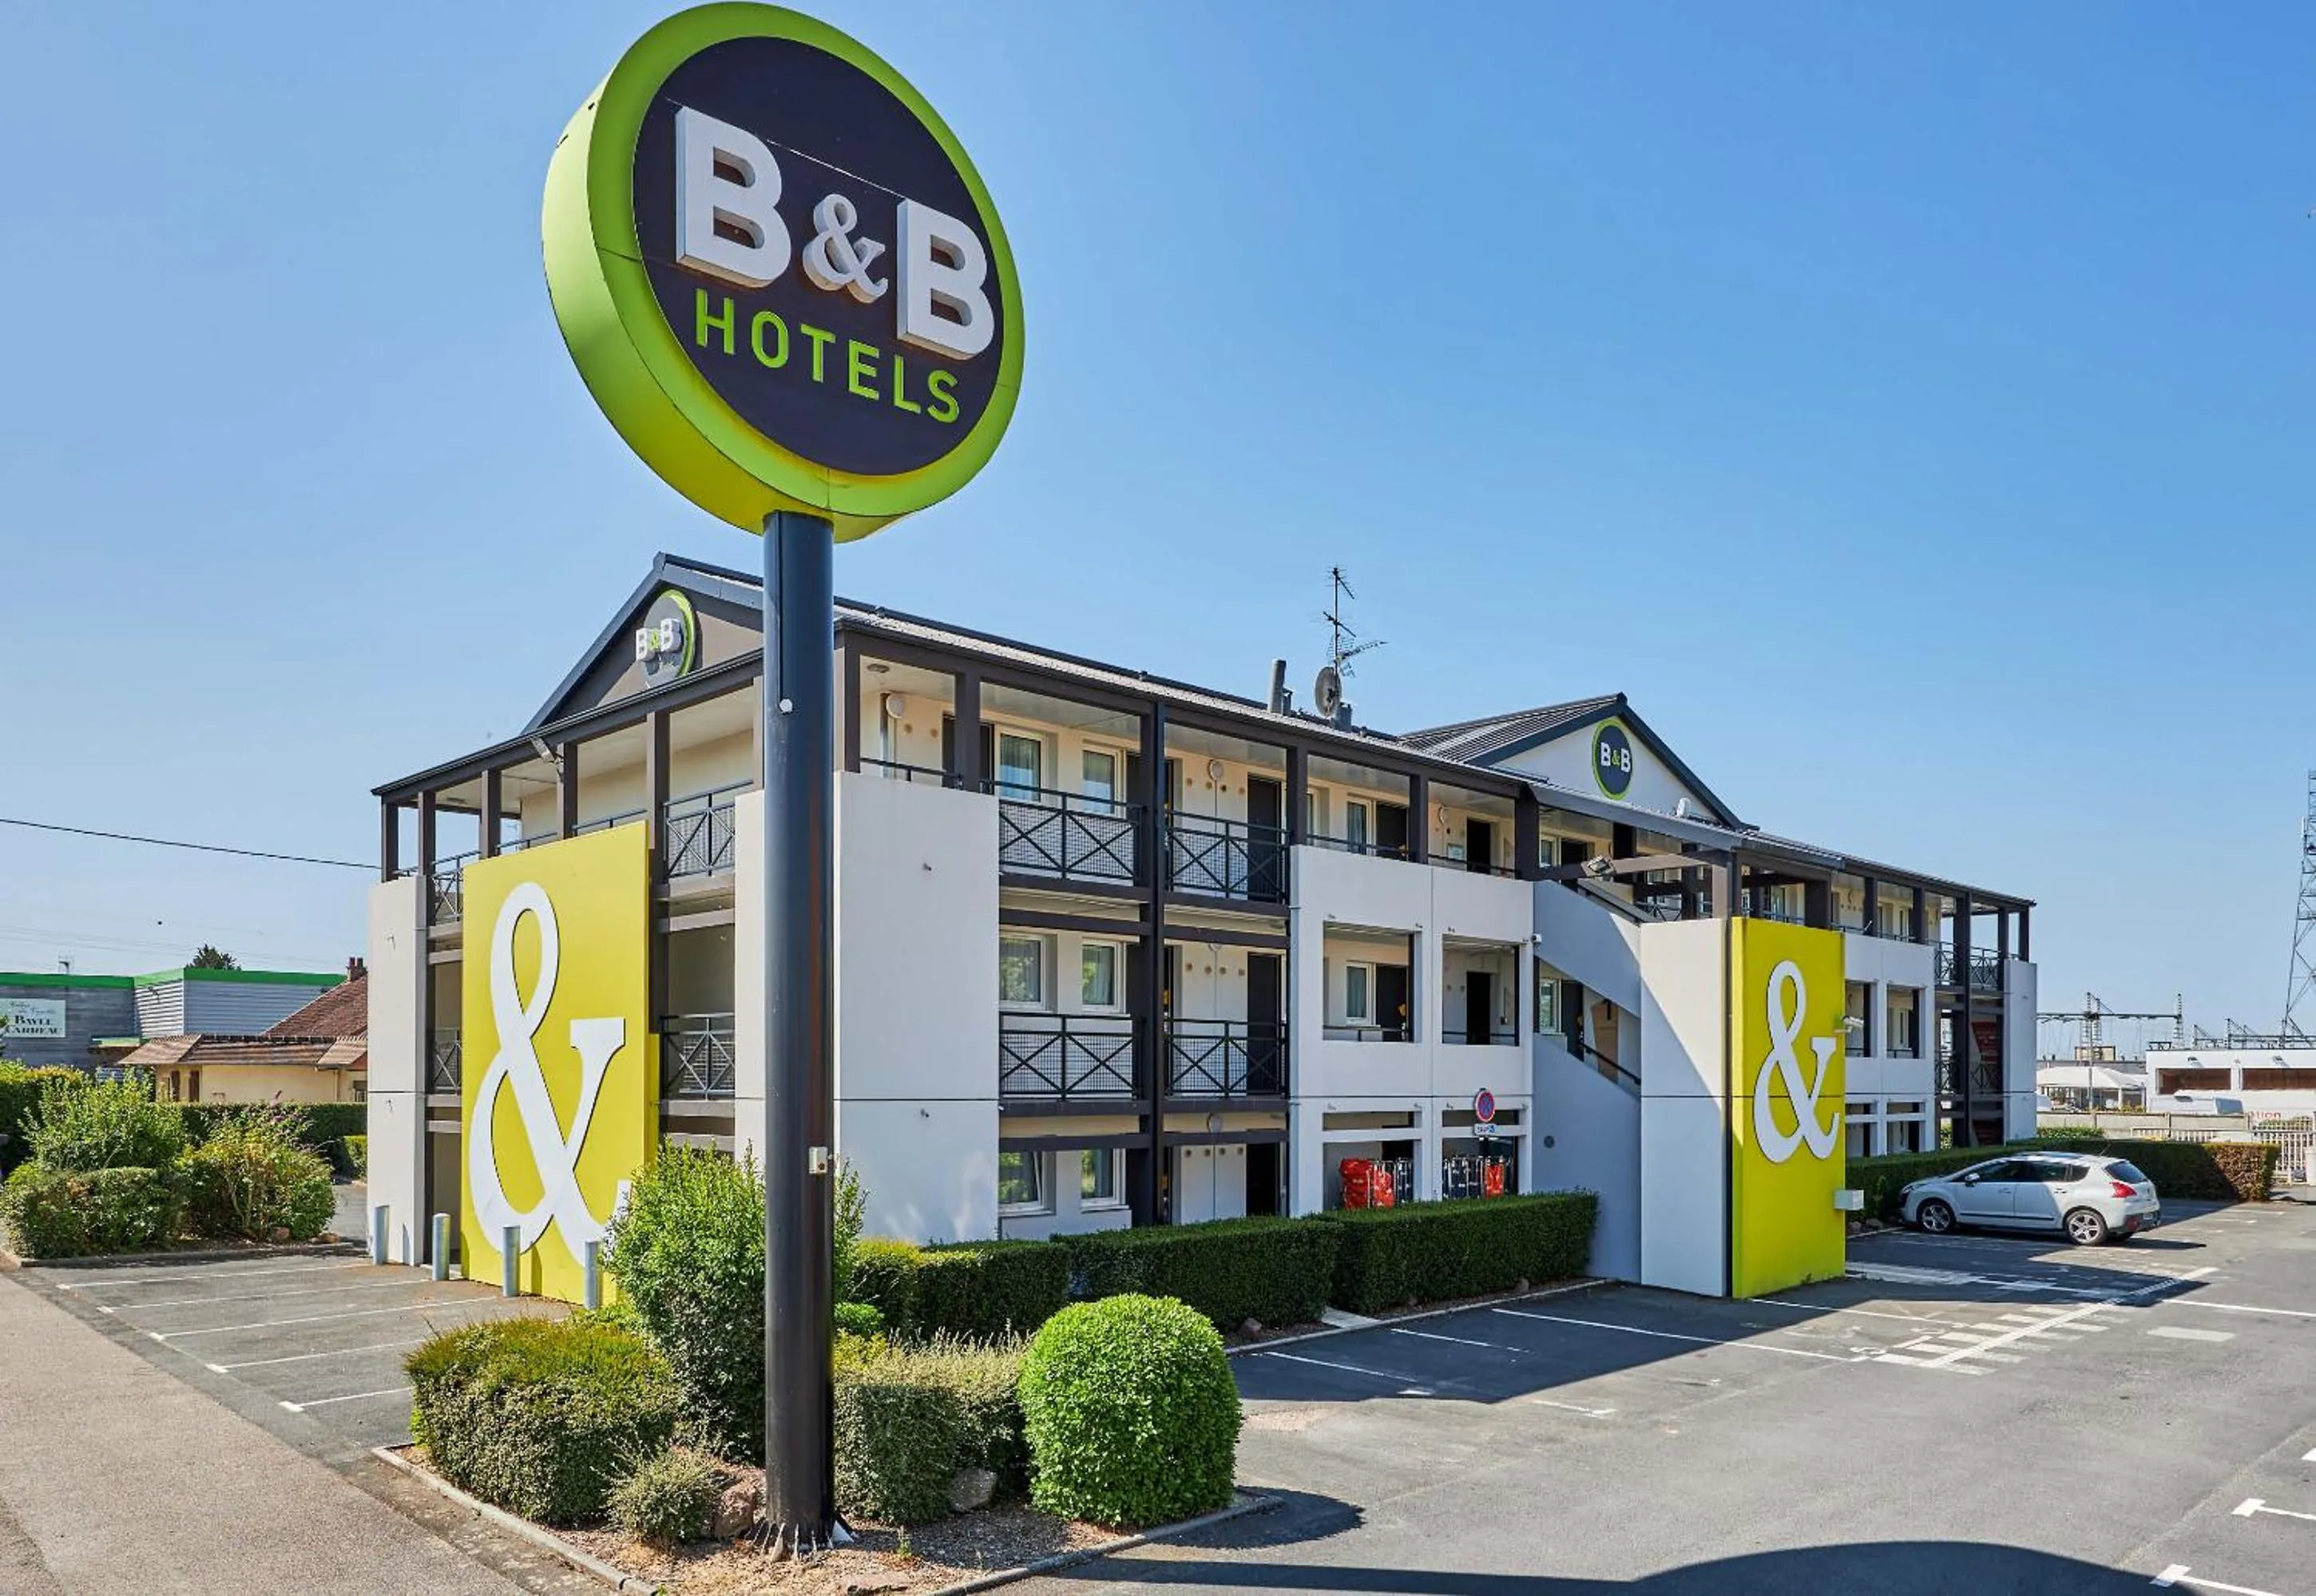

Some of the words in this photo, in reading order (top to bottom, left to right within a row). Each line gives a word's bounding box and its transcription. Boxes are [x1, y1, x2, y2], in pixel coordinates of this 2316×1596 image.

[676, 105, 994, 359] B&B
[696, 288, 960, 424] HOTELS
[636, 618, 681, 662] B&B
[1600, 742, 1630, 773] B&B
[469, 882, 631, 1270] &
[1753, 960, 1840, 1163] &
